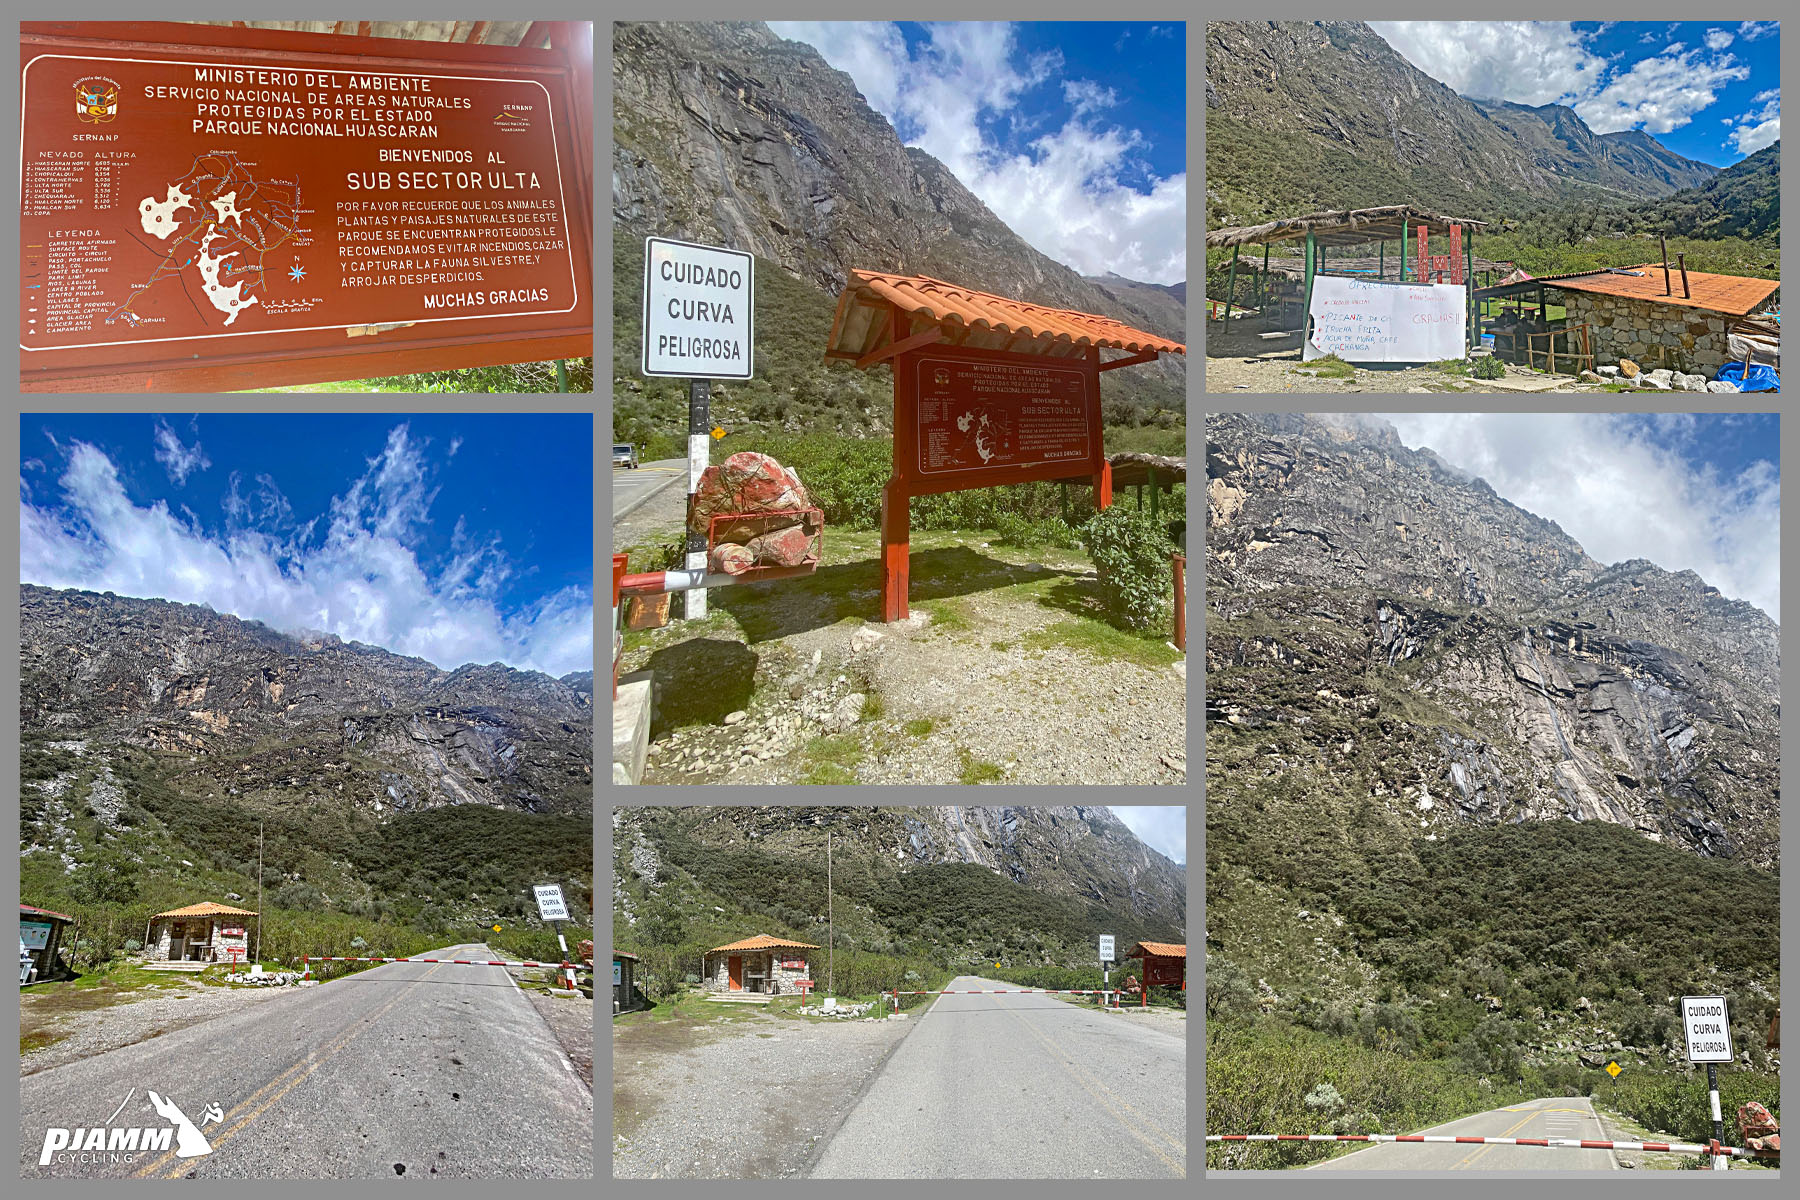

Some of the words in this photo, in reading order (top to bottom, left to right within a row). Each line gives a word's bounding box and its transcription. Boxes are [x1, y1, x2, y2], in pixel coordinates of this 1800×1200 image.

[195, 68, 299, 87] MINISTERIO
[305, 74, 342, 90] DEL
[349, 76, 432, 93] AMBIENTE
[144, 85, 220, 101] SERVICIO
[225, 89, 301, 105] NACIONAL
[307, 92, 328, 105] DE
[334, 94, 386, 107] AREAS
[391, 96, 472, 109] NATURALES
[197, 104, 306, 120] PROTEGIDAS
[312, 108, 345, 121] POR
[350, 109, 370, 122] EL
[375, 109, 433, 122] ESTADO
[192, 119, 262, 136] PARQUE
[267, 121, 344, 137] NACIONAL
[346, 123, 439, 139] HUASCARAN
[72, 133, 119, 142] SERNANP
[39, 151, 84, 159] NEVADO
[94, 151, 137, 159] ALTURA
[379, 149, 473, 163] BIENVENIDOS
[487, 152, 506, 164] AL
[347, 172, 391, 190] SUB
[398, 172, 483, 190] SECTOR
[488, 172, 541, 190] ULTA
[336, 202, 360, 212] POR
[362, 201, 399, 211] FAVOR
[402, 201, 460, 211] RECUERDE
[461, 201, 482, 211] QUE
[484, 200, 504, 210] LOS
[506, 199, 556, 210] ANIMALES
[337, 216, 389, 227] PLANTAS
[391, 216, 398, 225] Y
[400, 215, 454, 226] PAISAJES
[455, 214, 516, 225] NATURALES
[517, 213, 531, 223] DE
[532, 213, 558, 223] ESTE
[48, 229, 101, 239] LEYENDA
[338, 230, 383, 242] PARQUE
[386, 230, 401, 241] SE
[403, 229, 477, 240] ENCUENTRAN
[339, 243, 436, 257] RECOMENDAMOS
[438, 243, 478, 254] EVITAR
[340, 262, 347, 272] Y
[350, 260, 413, 272] CAPTURAR
[416, 259, 431, 270] LA
[433, 258, 471, 269] FAUNA
[341, 276, 397, 288] ARROJAR
[661, 260, 742, 290] CUIDADO
[423, 292, 485, 309] MUCHAS
[489, 288, 549, 304] GRACIAS
[667, 298, 734, 324] CURVA
[658, 335, 741, 360] PELIGROSA
[1688, 1006, 1722, 1017] CUIDADO
[1693, 1023, 1722, 1035] CURVA
[1692, 1041, 1728, 1053] PELIGROSA
